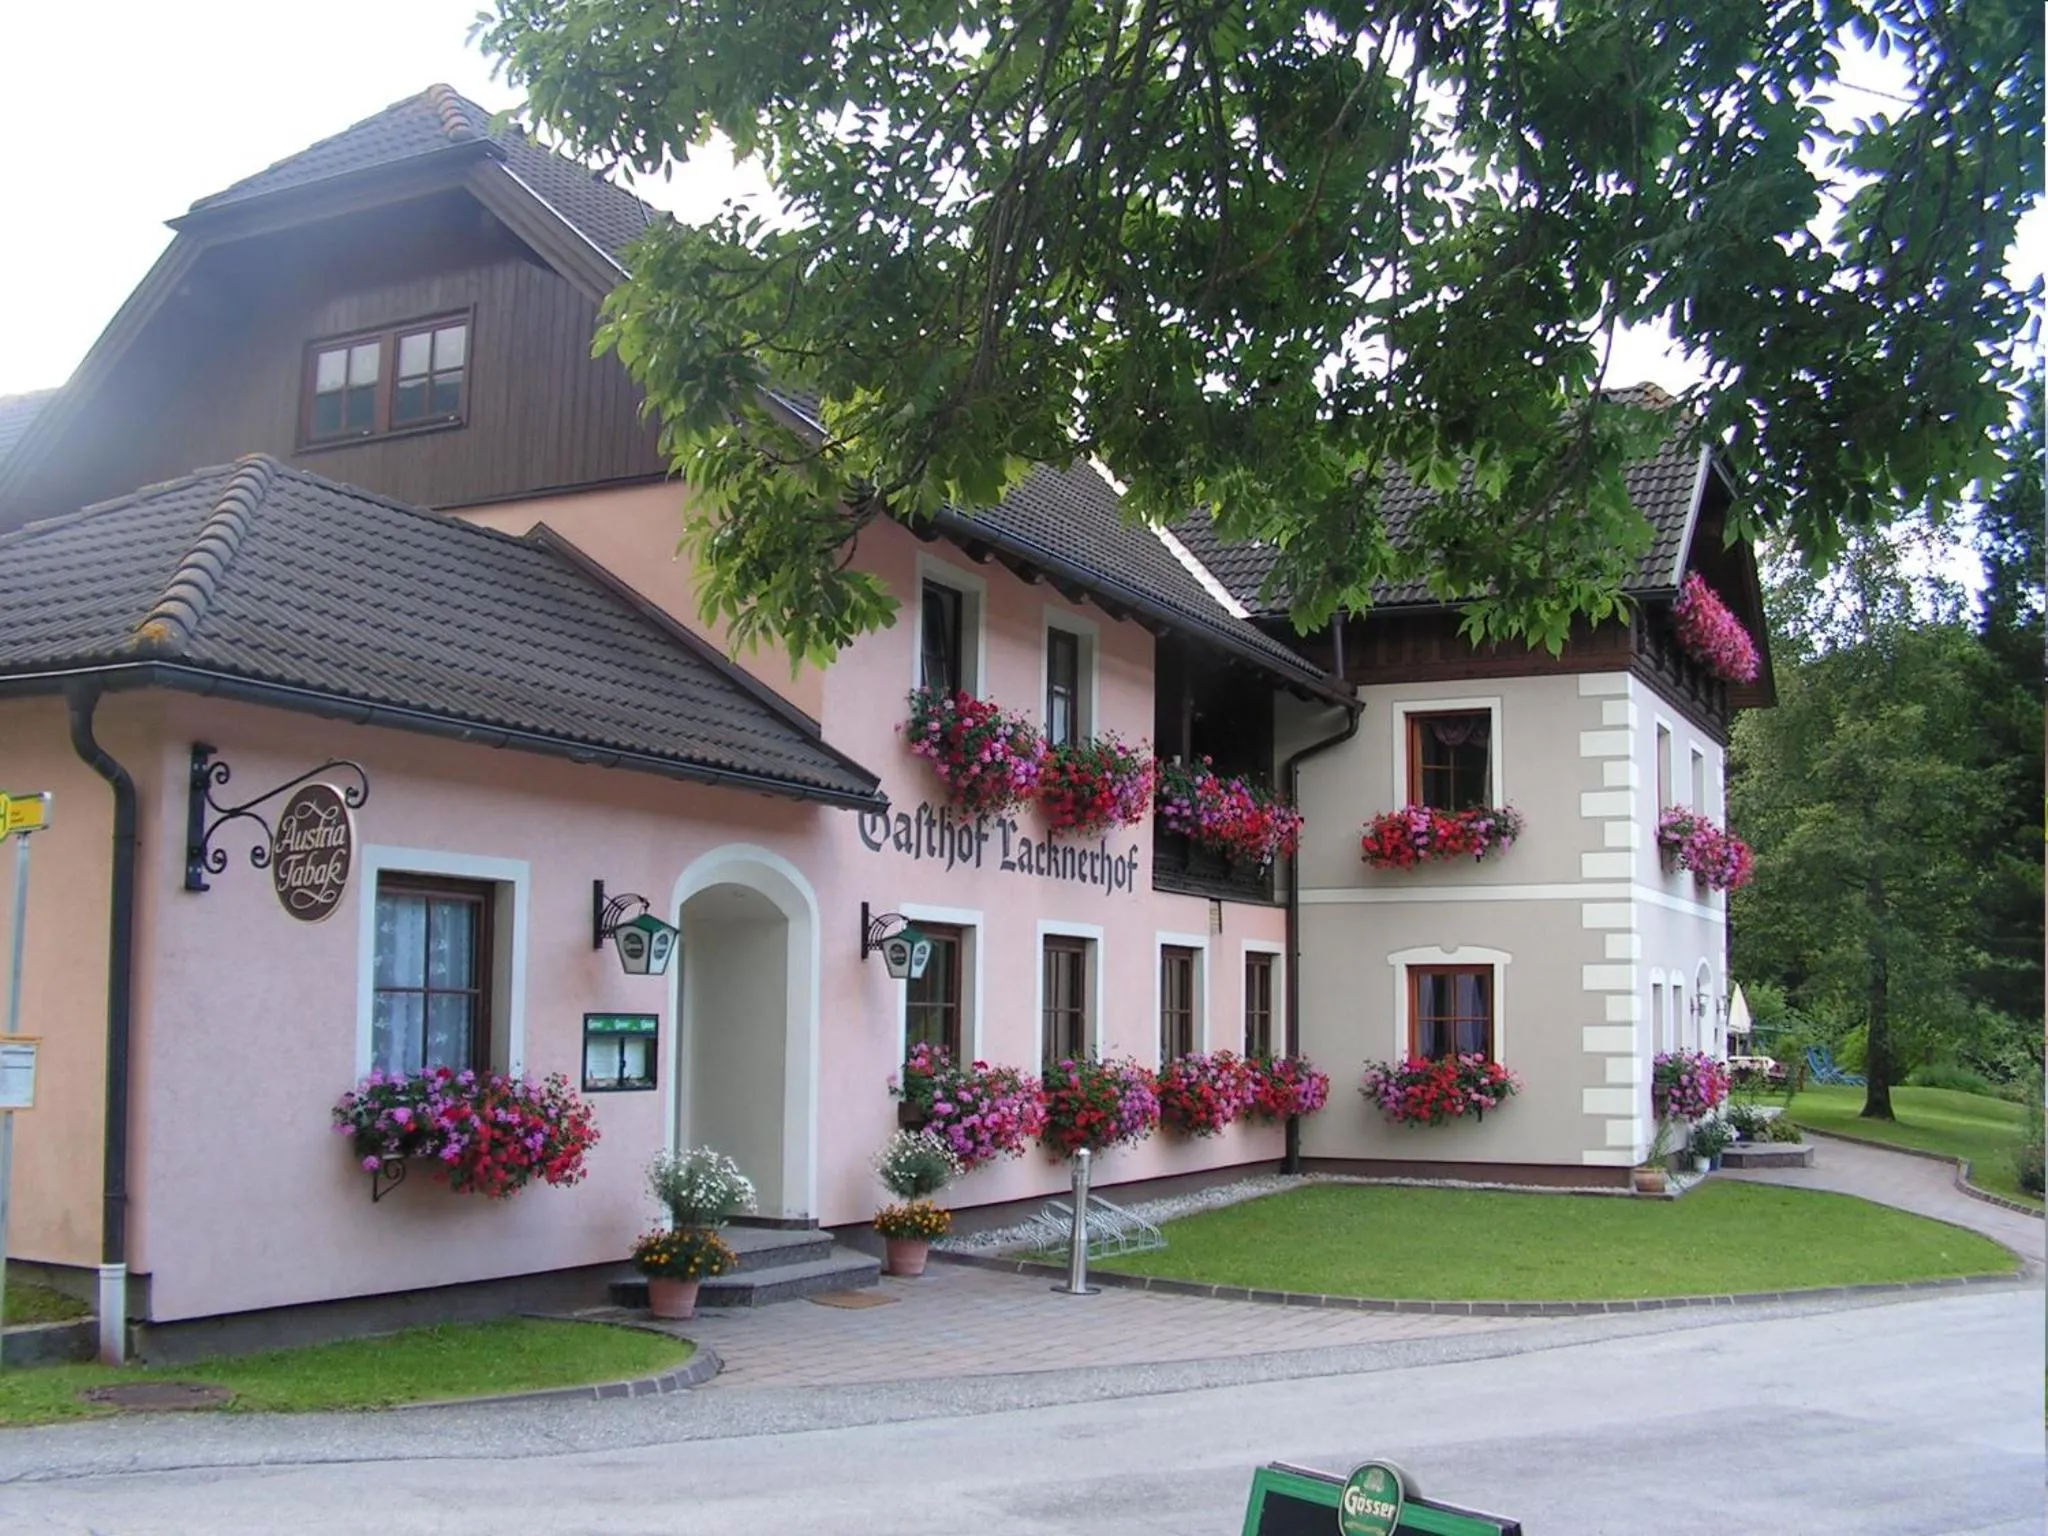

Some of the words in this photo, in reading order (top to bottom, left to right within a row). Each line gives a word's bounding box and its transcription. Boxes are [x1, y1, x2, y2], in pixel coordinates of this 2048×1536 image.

[275, 801, 347, 854] Austria
[277, 849, 347, 909] Tabak
[996, 818, 1139, 897] Lacknerhof
[1344, 1485, 1397, 1520] Gösser
